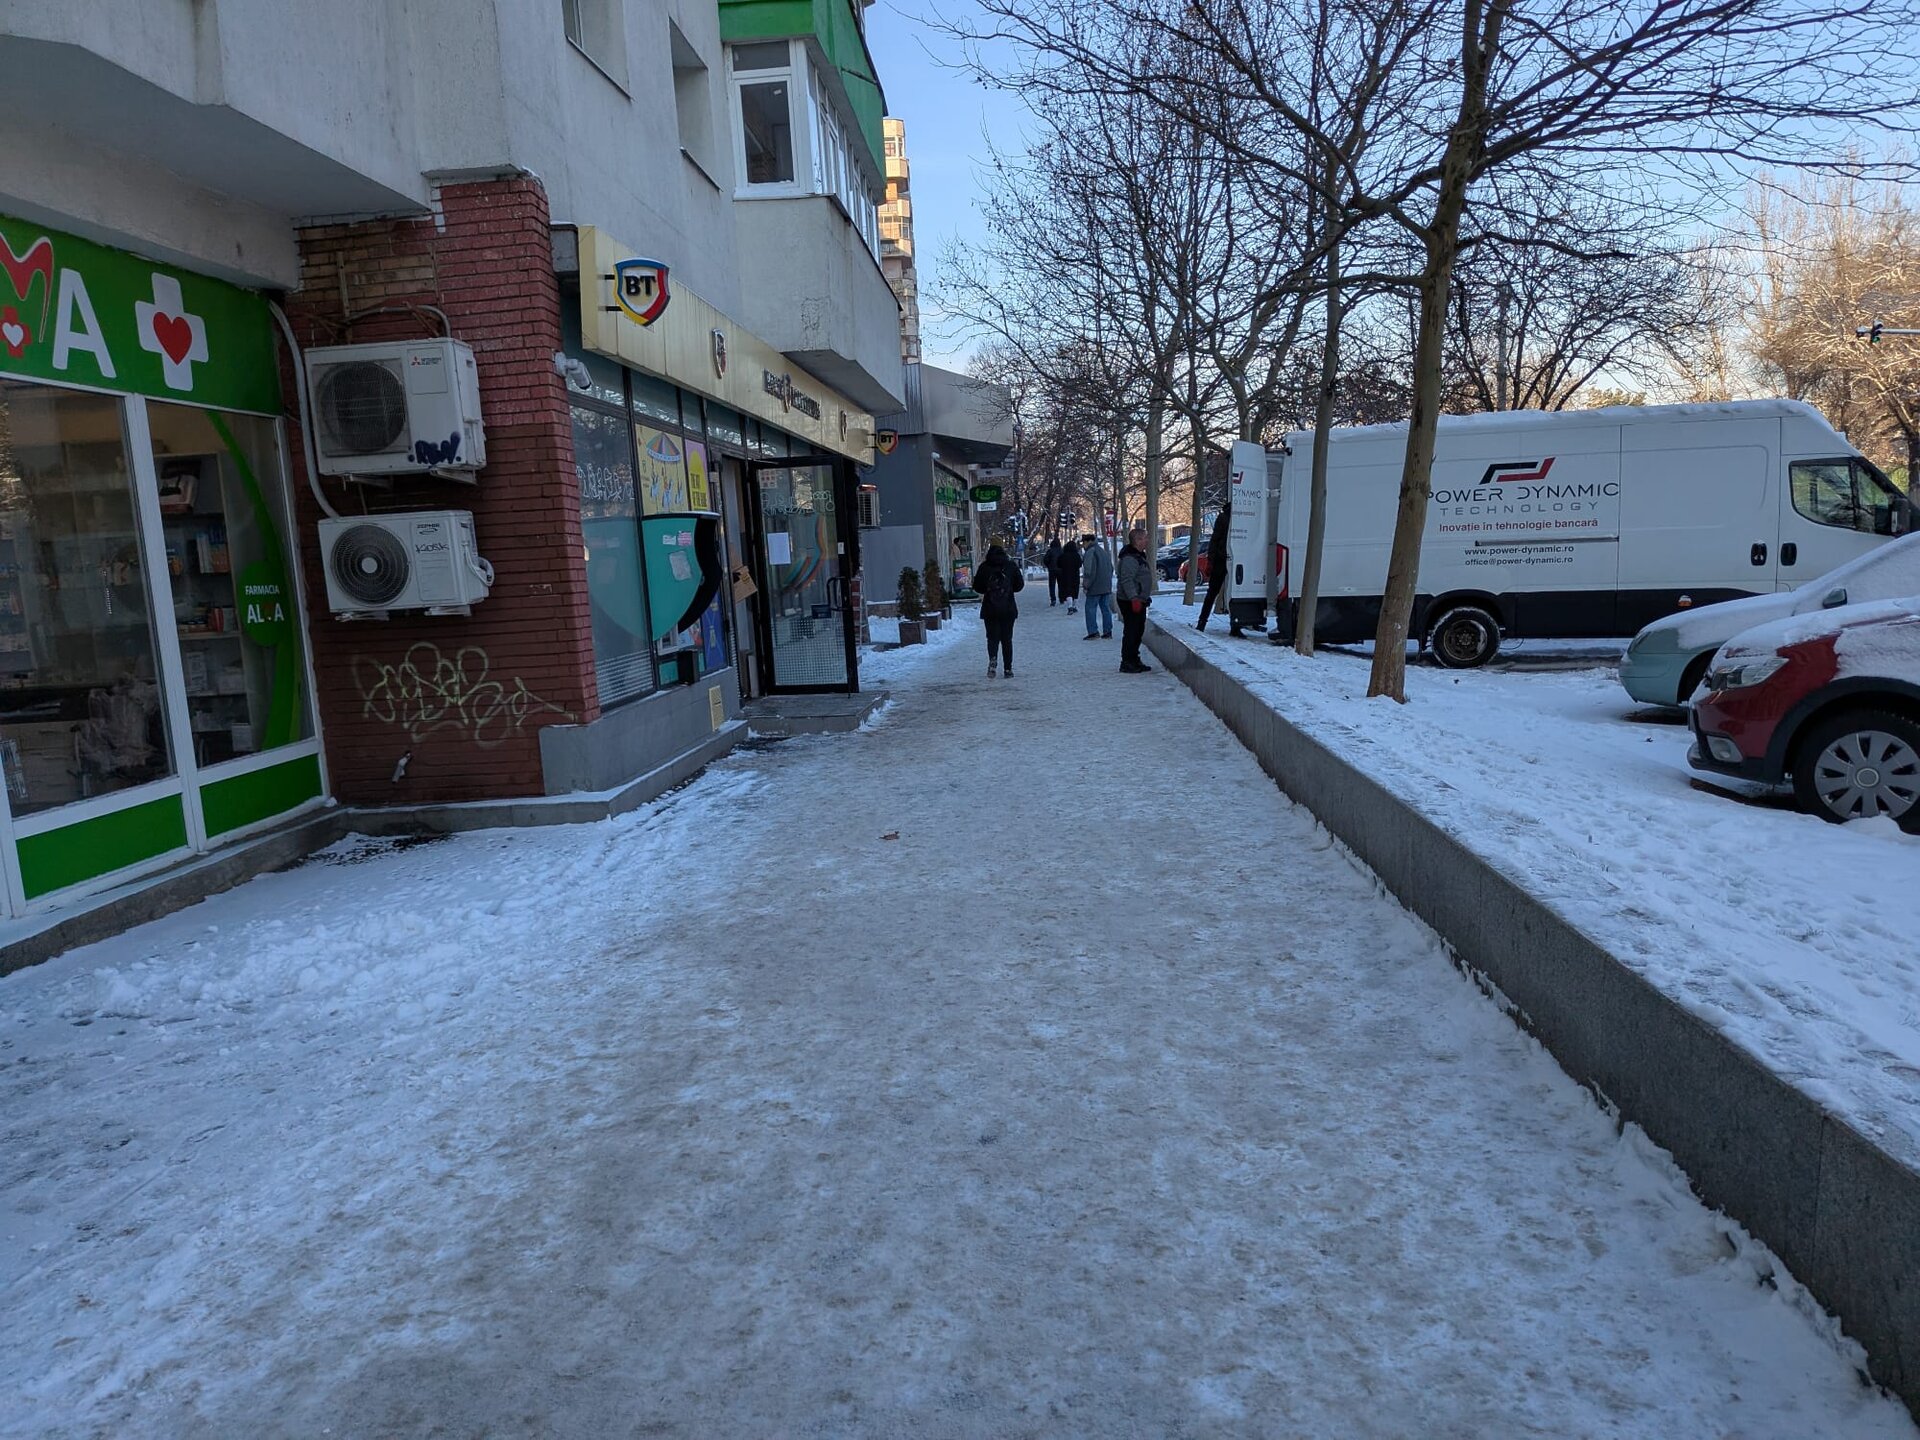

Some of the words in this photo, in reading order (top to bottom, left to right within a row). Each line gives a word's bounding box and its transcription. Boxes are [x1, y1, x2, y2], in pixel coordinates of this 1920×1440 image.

[624, 275, 656, 297] BT
[880, 434, 894, 443] BT
[1517, 482, 1619, 499] DYNAMIC
[1440, 501, 1598, 516] TECHNOLOGY
[1495, 519, 1552, 531] tehnologie
[1464, 544, 1575, 556] www.power-dynamic.ro
[1464, 556, 1574, 566] office@power-dynamic.ro
[245, 585, 280, 595] FARMACIA
